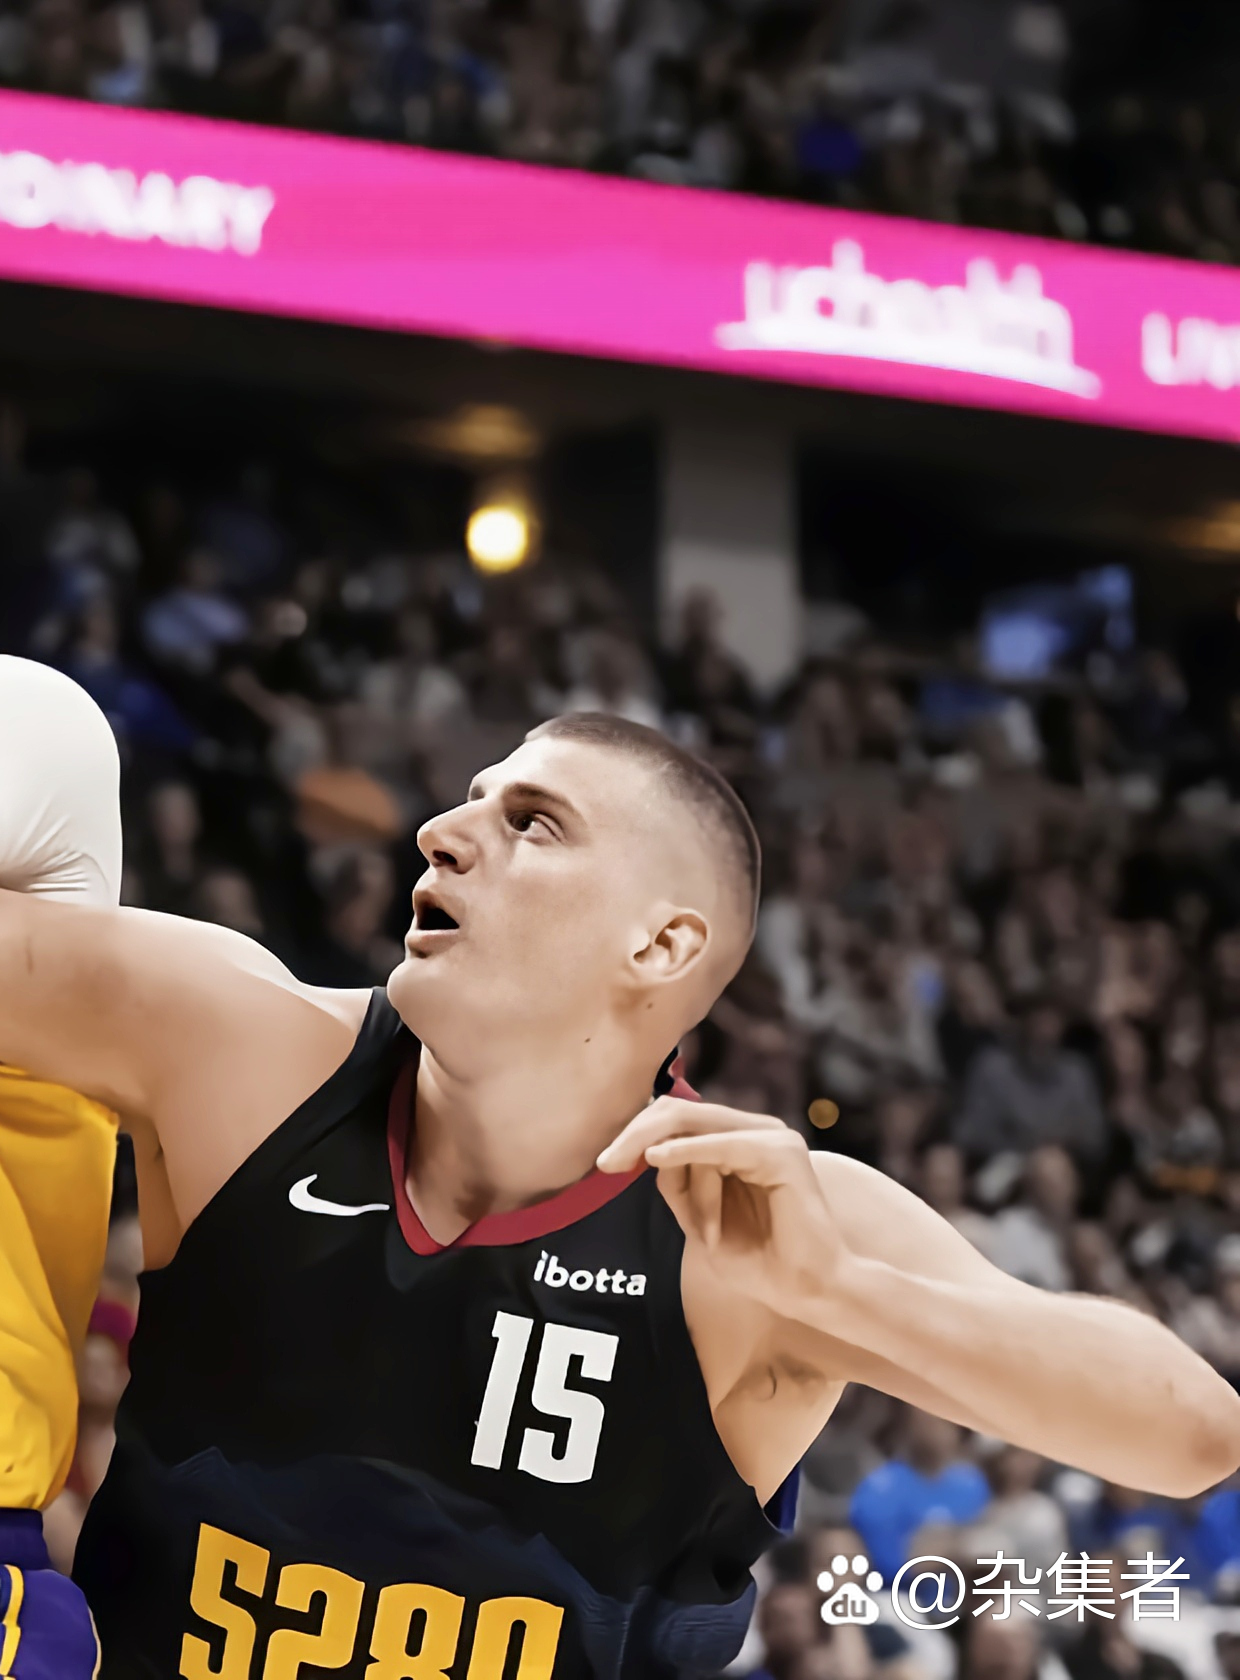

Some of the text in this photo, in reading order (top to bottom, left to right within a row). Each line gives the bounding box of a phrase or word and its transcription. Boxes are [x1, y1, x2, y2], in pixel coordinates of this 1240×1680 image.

[533, 1250, 648, 1296] ibotta
[471, 1310, 619, 1484] 15
[178, 1522, 565, 1680] 5280
